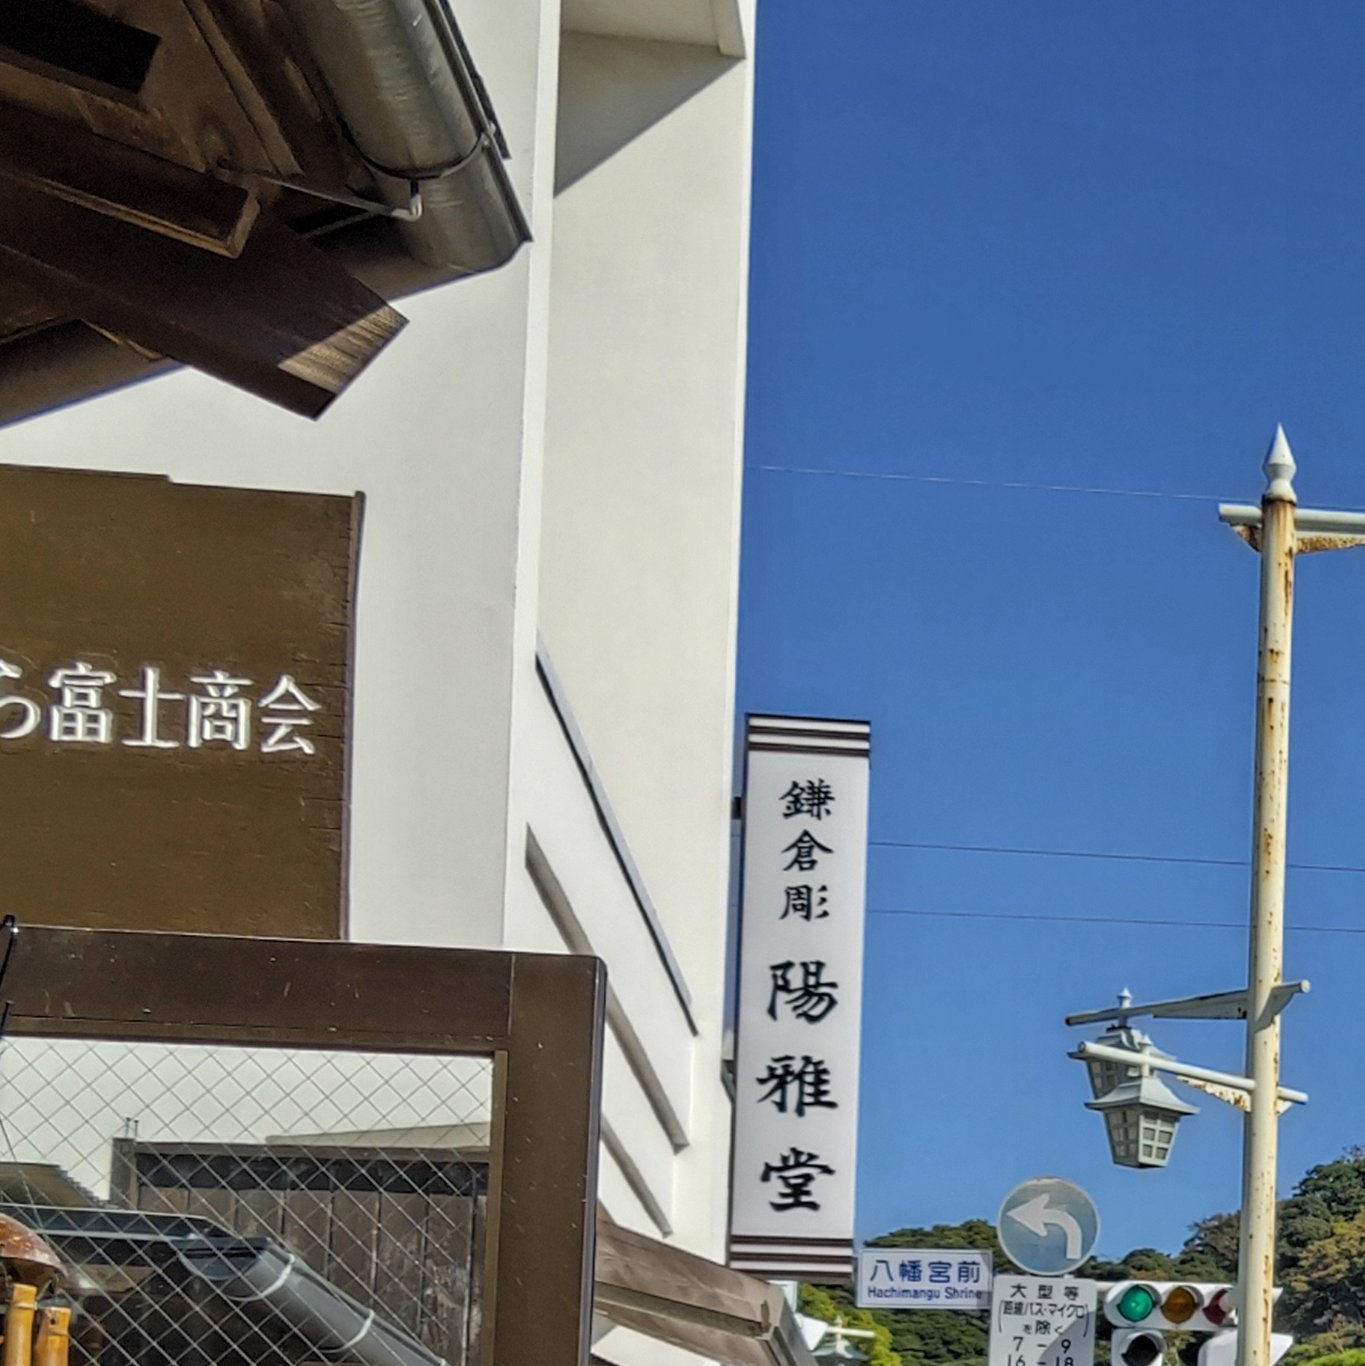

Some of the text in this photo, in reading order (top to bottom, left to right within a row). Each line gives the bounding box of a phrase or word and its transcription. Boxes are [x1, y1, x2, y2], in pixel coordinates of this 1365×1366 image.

[756, 778, 838, 1212] 鎌倉彫 陽雅堂
[870, 1259, 981, 1283] 八幡宮前
[867, 1286, 983, 1300] Hachimangu Shrine
